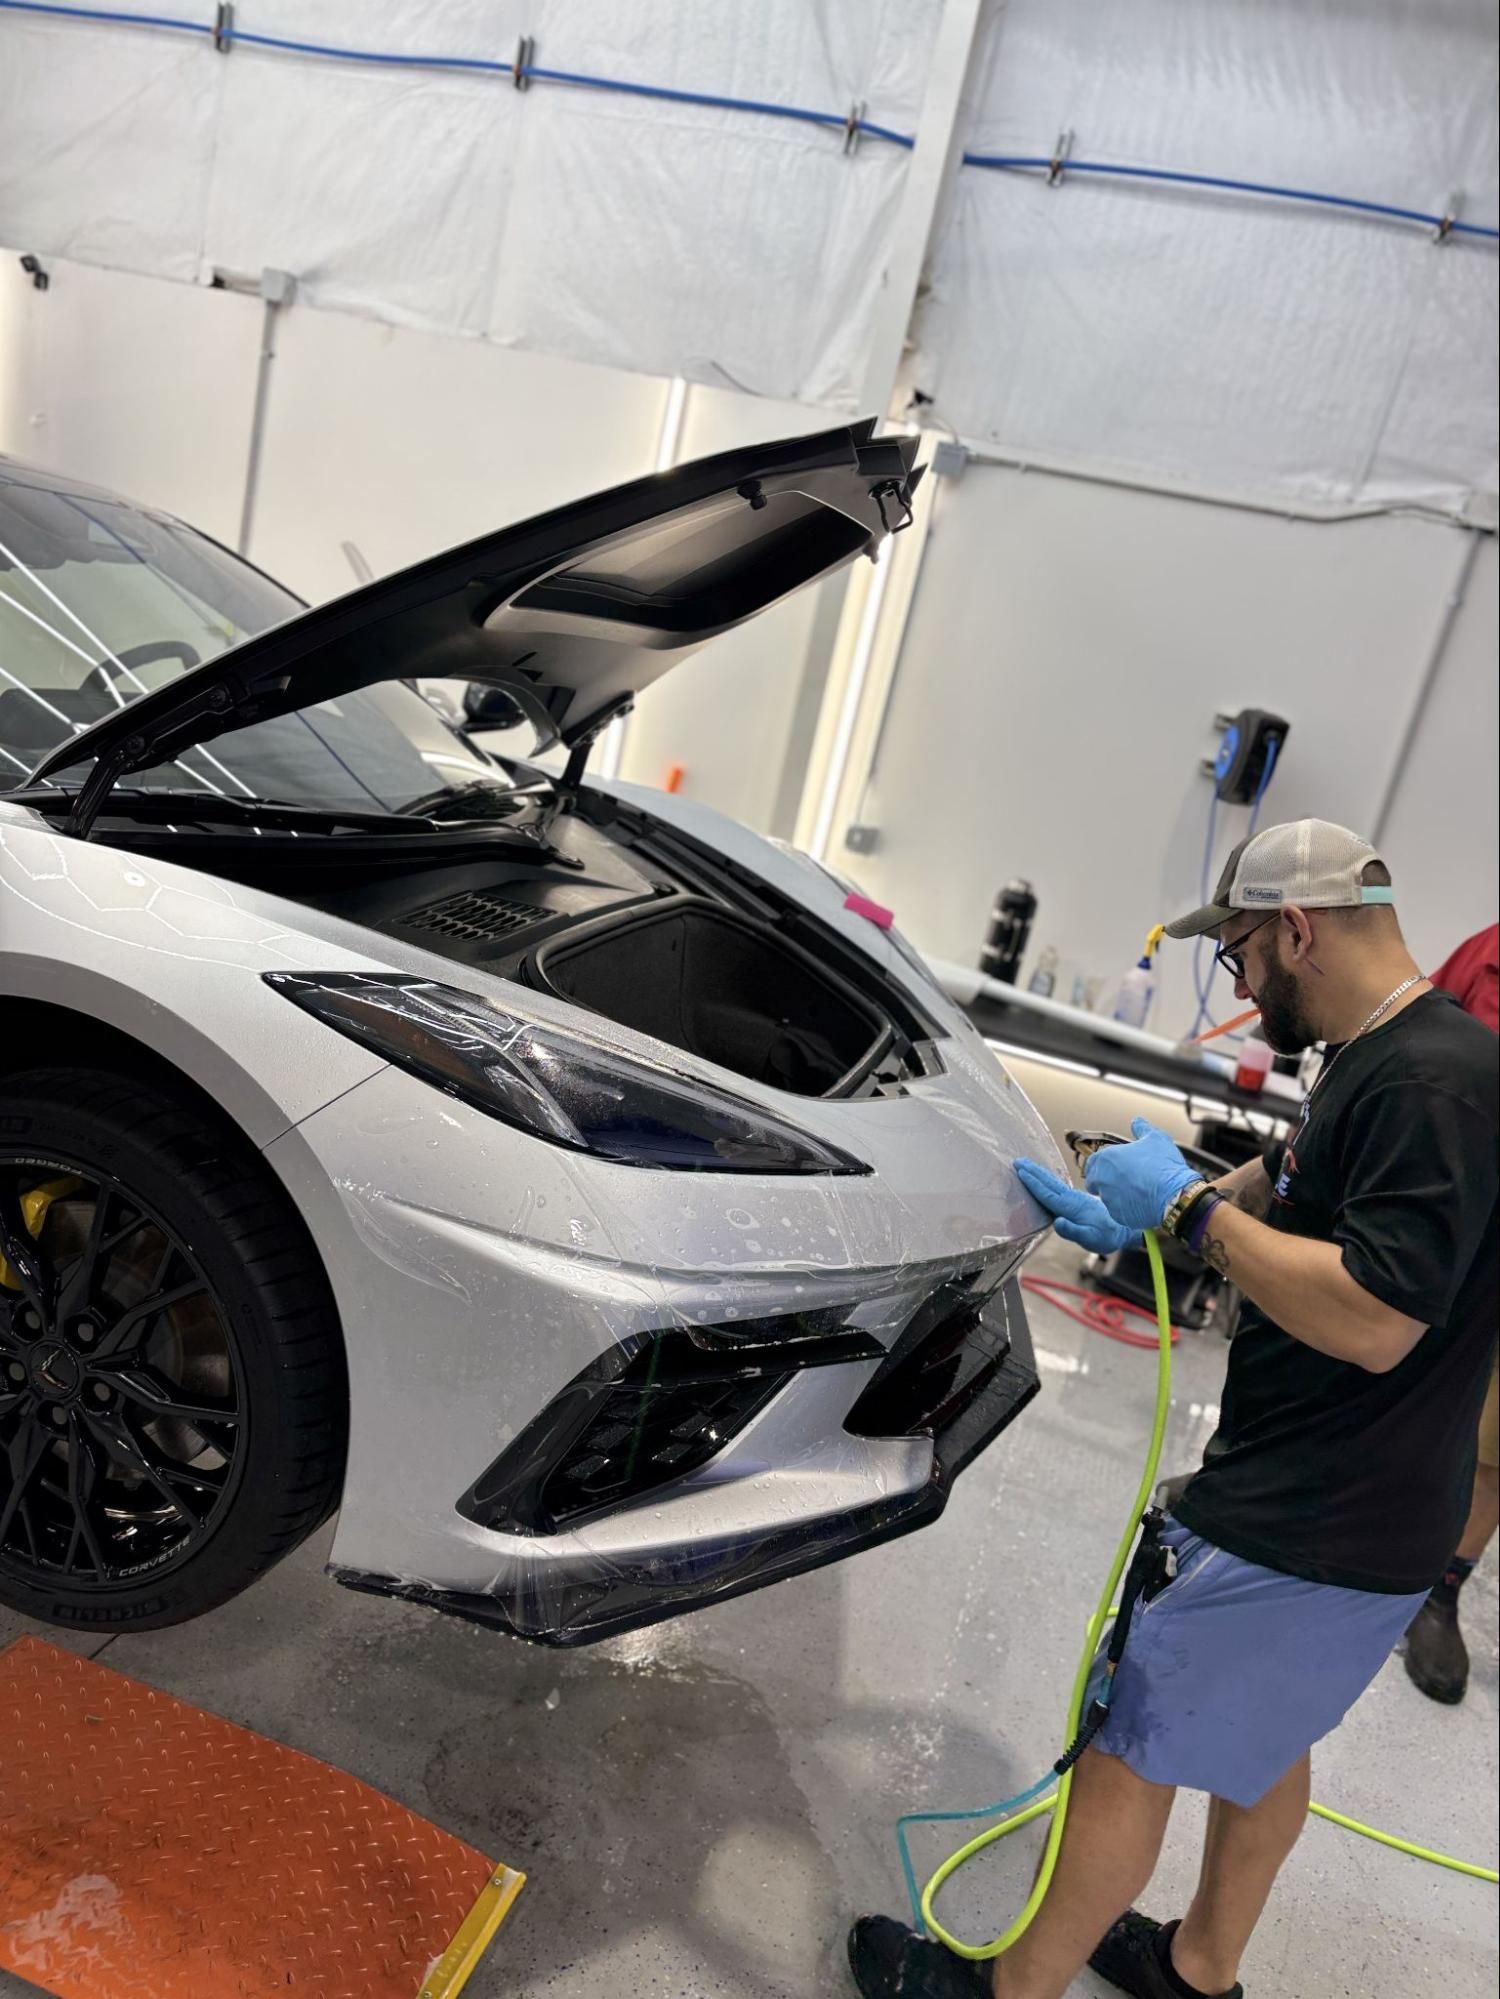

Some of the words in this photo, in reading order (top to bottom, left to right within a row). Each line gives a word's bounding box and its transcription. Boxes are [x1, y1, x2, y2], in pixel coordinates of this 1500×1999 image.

[1253, 889, 1279, 897] Columbia
[15, 1157, 83, 1175] FORGED
[119, 1535, 191, 1577] CORVETTE
